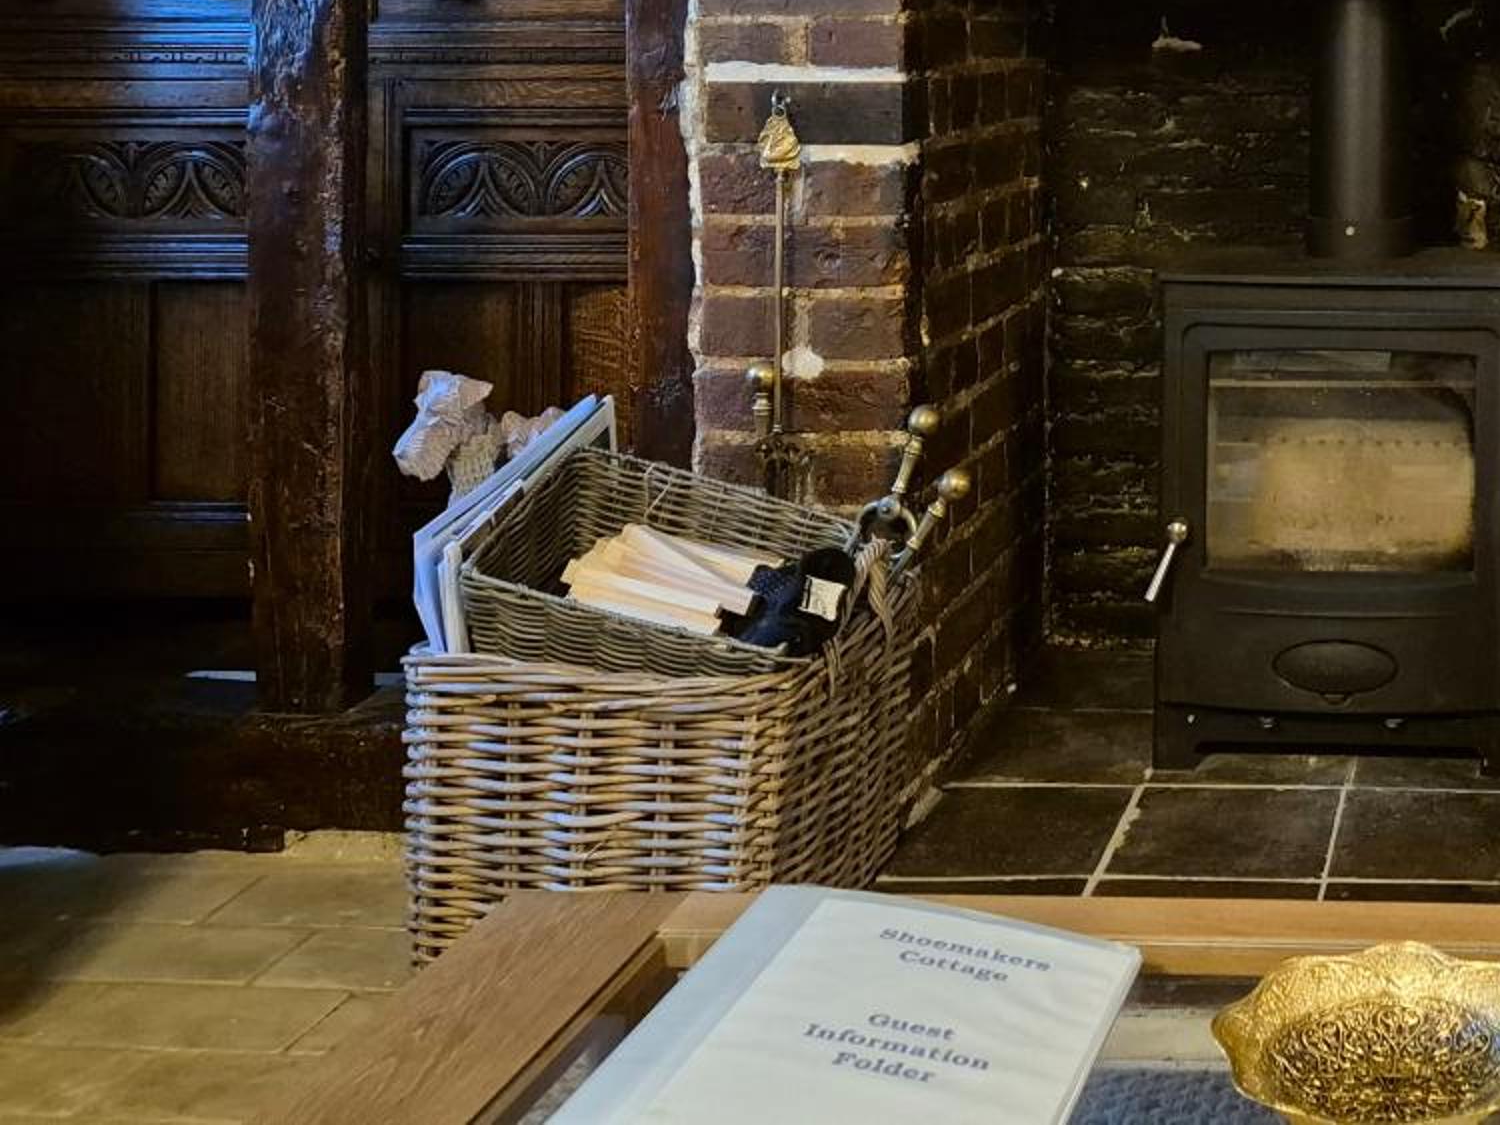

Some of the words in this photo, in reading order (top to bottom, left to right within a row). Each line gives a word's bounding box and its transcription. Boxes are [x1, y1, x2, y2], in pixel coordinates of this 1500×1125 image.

[879, 927, 1052, 973] Shoemakers
[899, 950, 1009, 982] Cottage
[867, 1013, 956, 1041] Guest
[803, 1023, 990, 1071] Information
[831, 1051, 937, 1083] Folder
